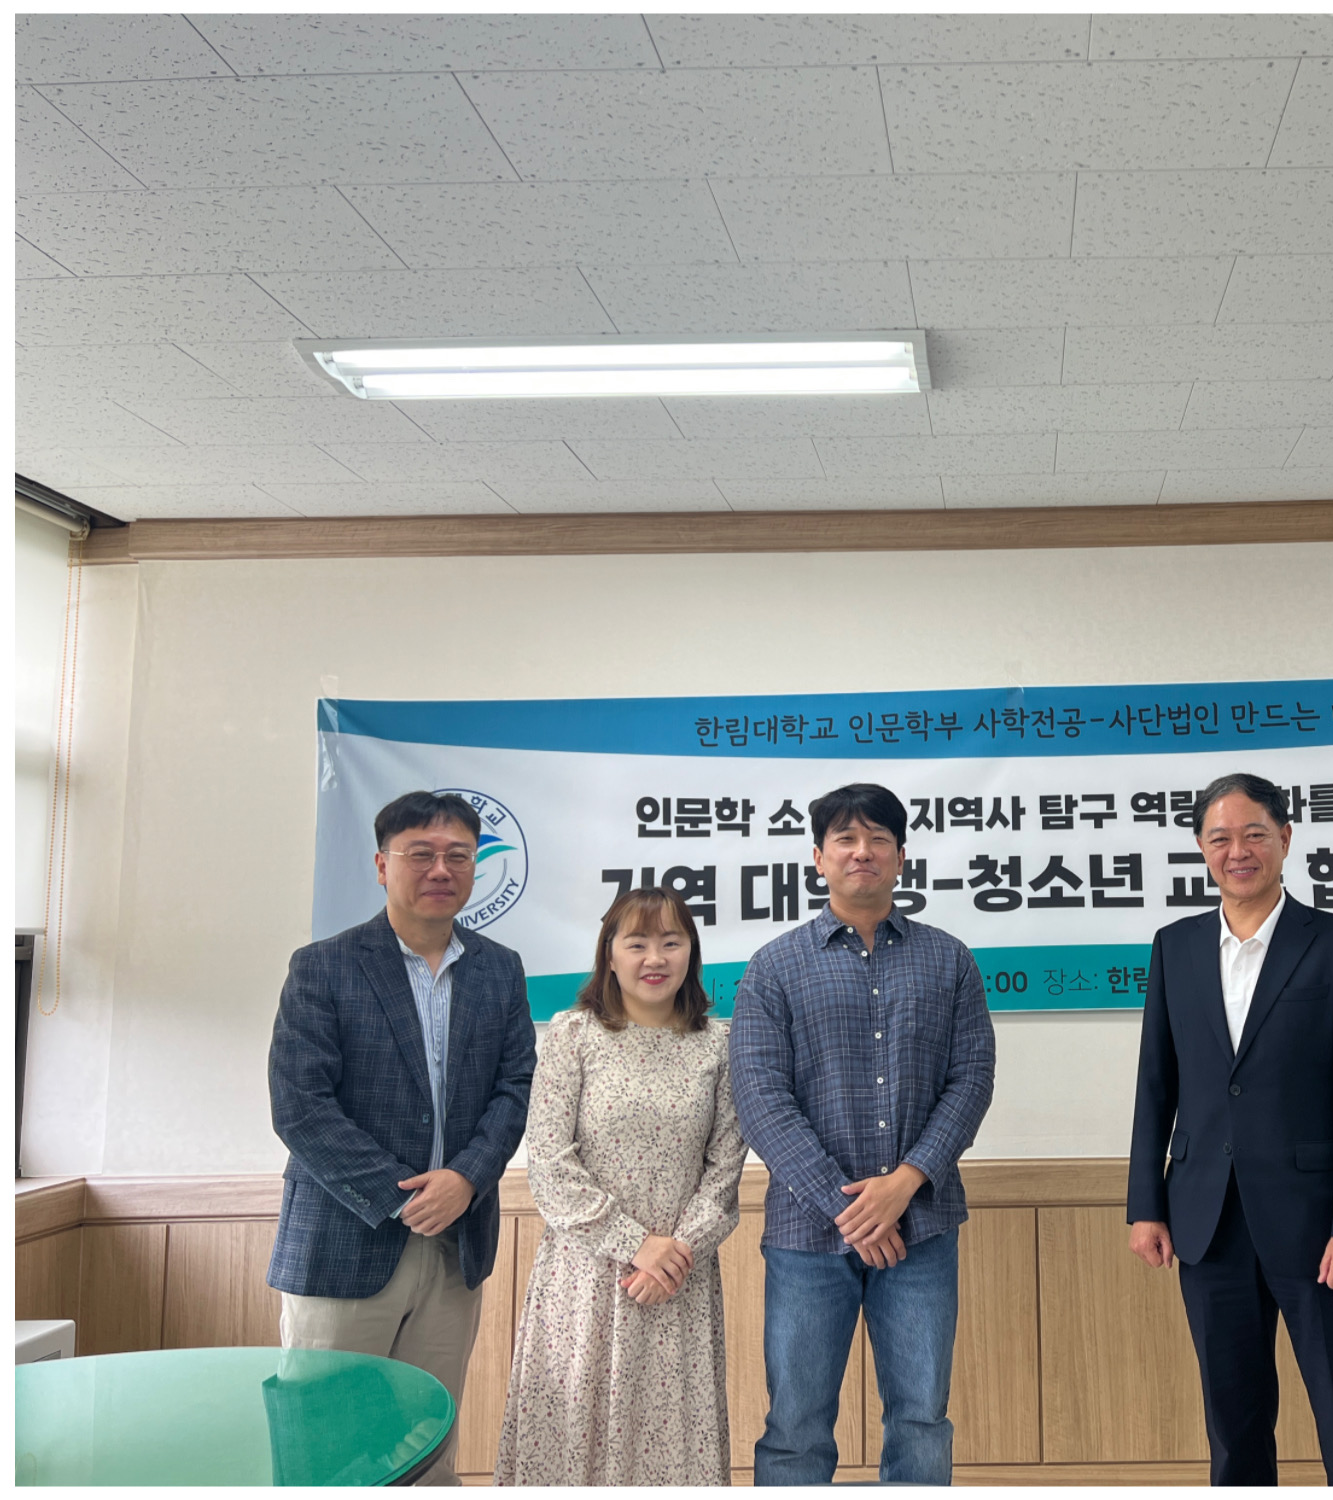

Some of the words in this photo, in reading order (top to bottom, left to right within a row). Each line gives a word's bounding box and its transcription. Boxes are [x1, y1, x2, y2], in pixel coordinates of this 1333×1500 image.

[695, 714, 839, 747] 한림대학교
[848, 711, 964, 744] 인문학부
[973, 702, 1219, 739] 사학전공-사단법인
[1231, 701, 1320, 734] 만드는
[636, 796, 755, 837] 인문학
[767, 798, 814, 836] 소
[909, 795, 1026, 833] 지역사
[1039, 794, 1118, 830] 탐구
[1043, 968, 1098, 996] 장소:
